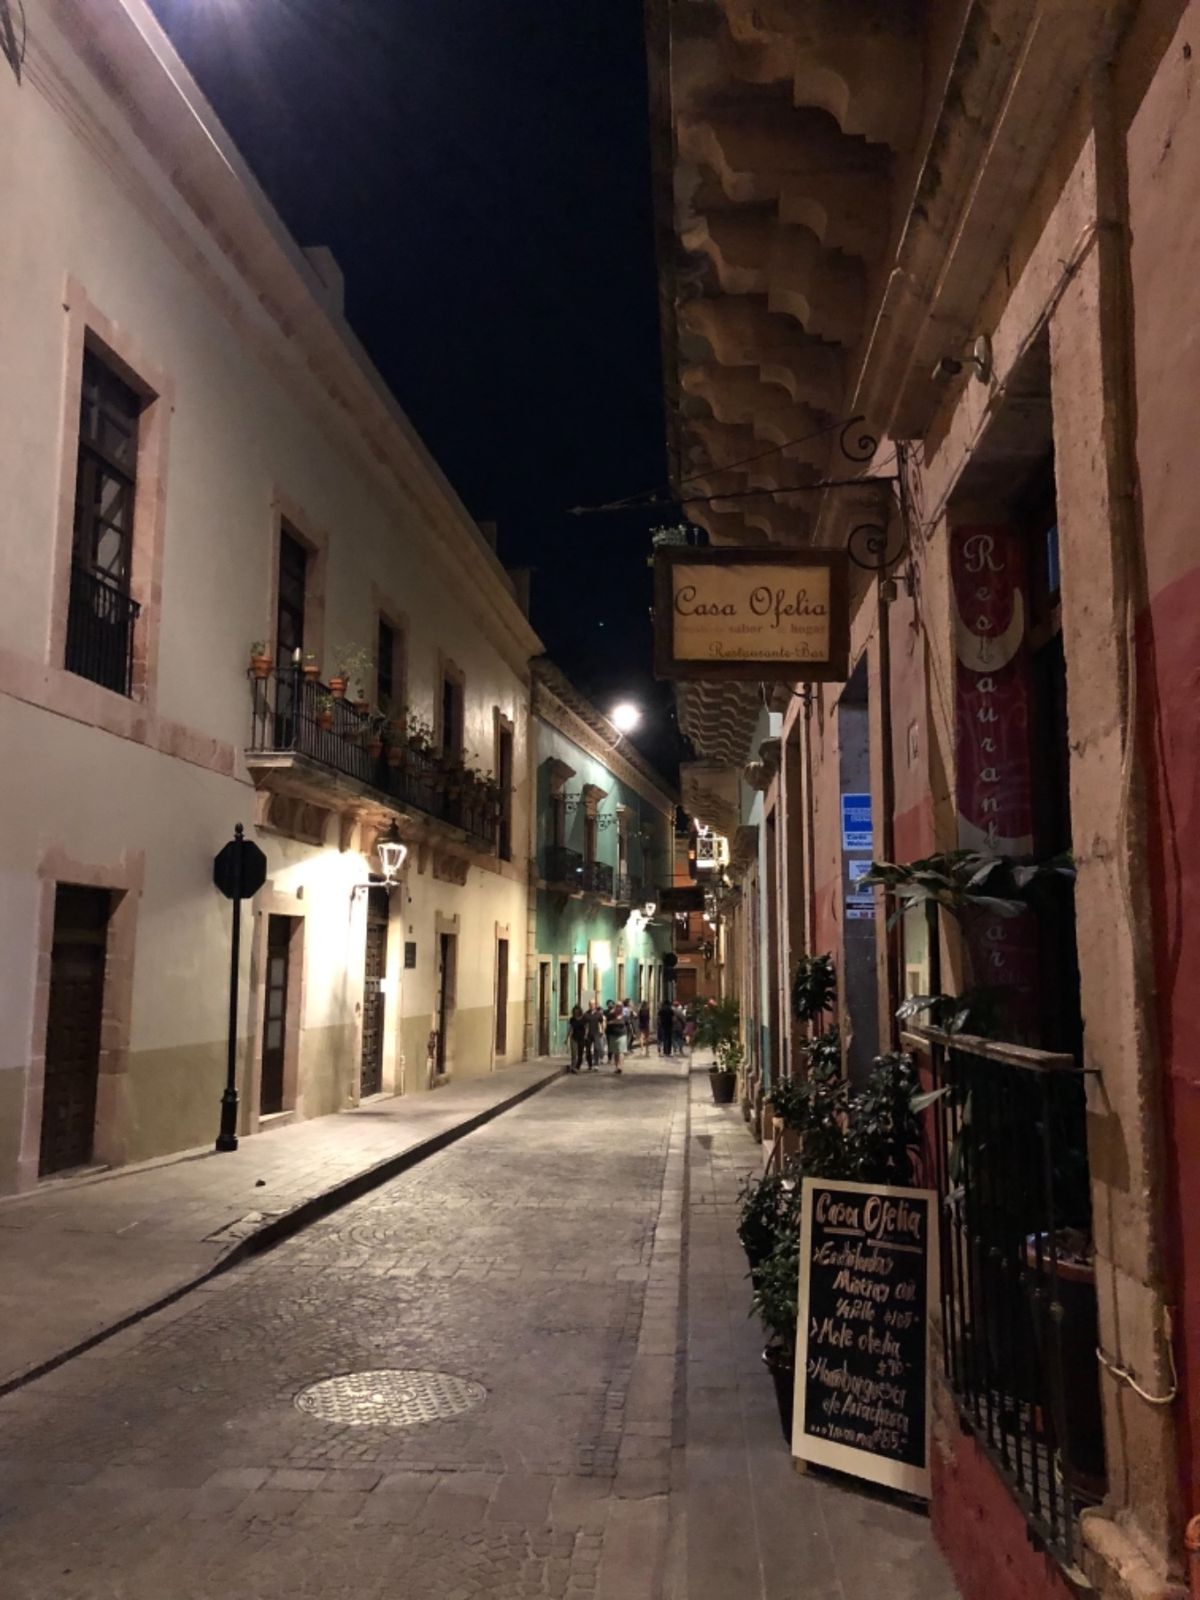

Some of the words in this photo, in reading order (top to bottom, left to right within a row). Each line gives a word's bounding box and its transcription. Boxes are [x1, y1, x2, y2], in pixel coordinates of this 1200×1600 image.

[675, 585, 737, 617] Casa
[749, 586, 827, 629] Ofelia
[815, 1192, 860, 1228] Casa
[863, 1196, 921, 1239] Ofelia
[817, 1317, 854, 1348] Mole
